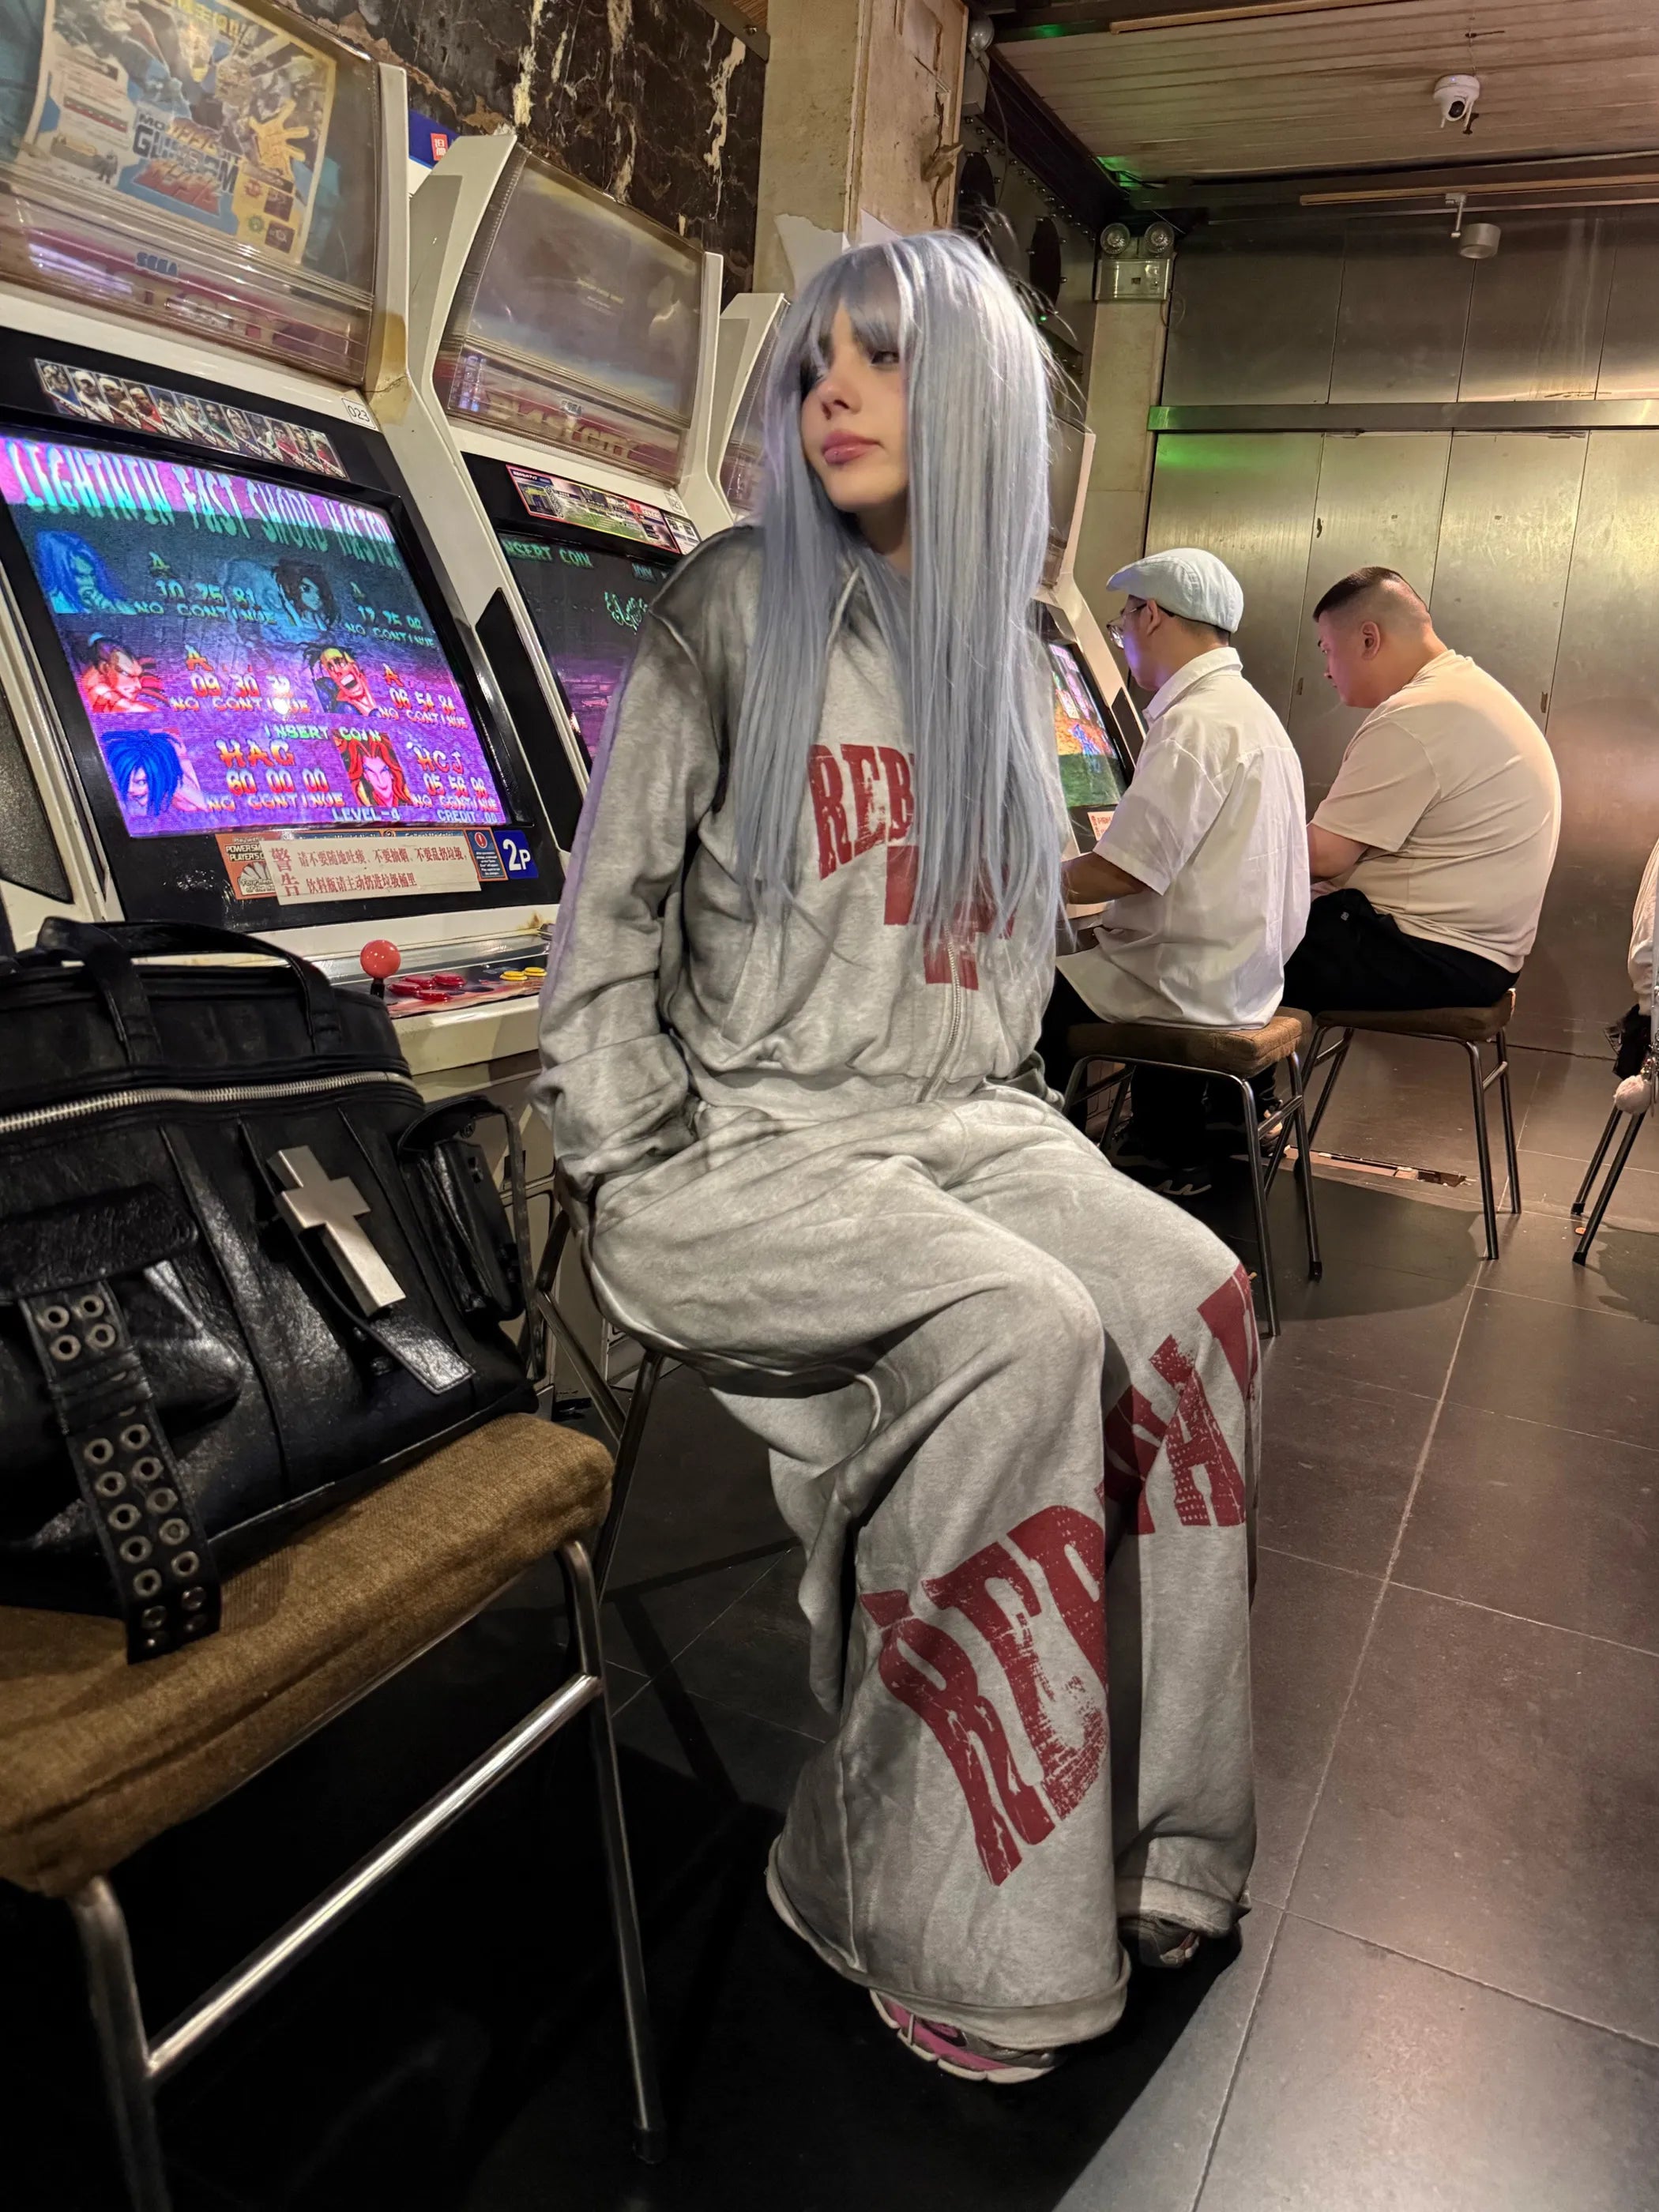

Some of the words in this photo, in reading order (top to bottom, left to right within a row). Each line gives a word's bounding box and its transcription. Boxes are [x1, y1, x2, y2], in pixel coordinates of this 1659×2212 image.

[136, 251, 179, 276] SEGA
[347, 405, 371, 423] 023
[171, 465, 251, 540] FAST
[246, 479, 329, 553] SWORD
[501, 539, 553, 562] NSERT
[133, 600, 164, 615] NO
[175, 602, 277, 624] CONTINUE
[344, 622, 366, 635] NO
[184, 644, 215, 672] A
[190, 673, 223, 698] 09
[229, 673, 261, 698] 30
[382, 662, 404, 687] A
[168, 696, 201, 712] NO
[212, 696, 312, 714] CONTIUE
[378, 705, 400, 721] NO
[405, 709, 469, 730] CONTINUE
[263, 722, 329, 740] INSERT
[338, 725, 382, 743] COIN
[412, 746, 465, 775] HCJ
[225, 769, 258, 797] 60
[265, 767, 296, 795] 00
[301, 767, 330, 794] 00
[423, 772, 446, 797] 05
[206, 792, 237, 813] NO
[246, 791, 346, 811] CONTINUE
[410, 792, 434, 809] NO
[438, 794, 500, 813] CONTINUE
[807, 743, 915, 882] REB
[436, 809, 477, 823] CREDIT
[502, 838, 531, 871] 2P
[270, 847, 299, 897] 警告
